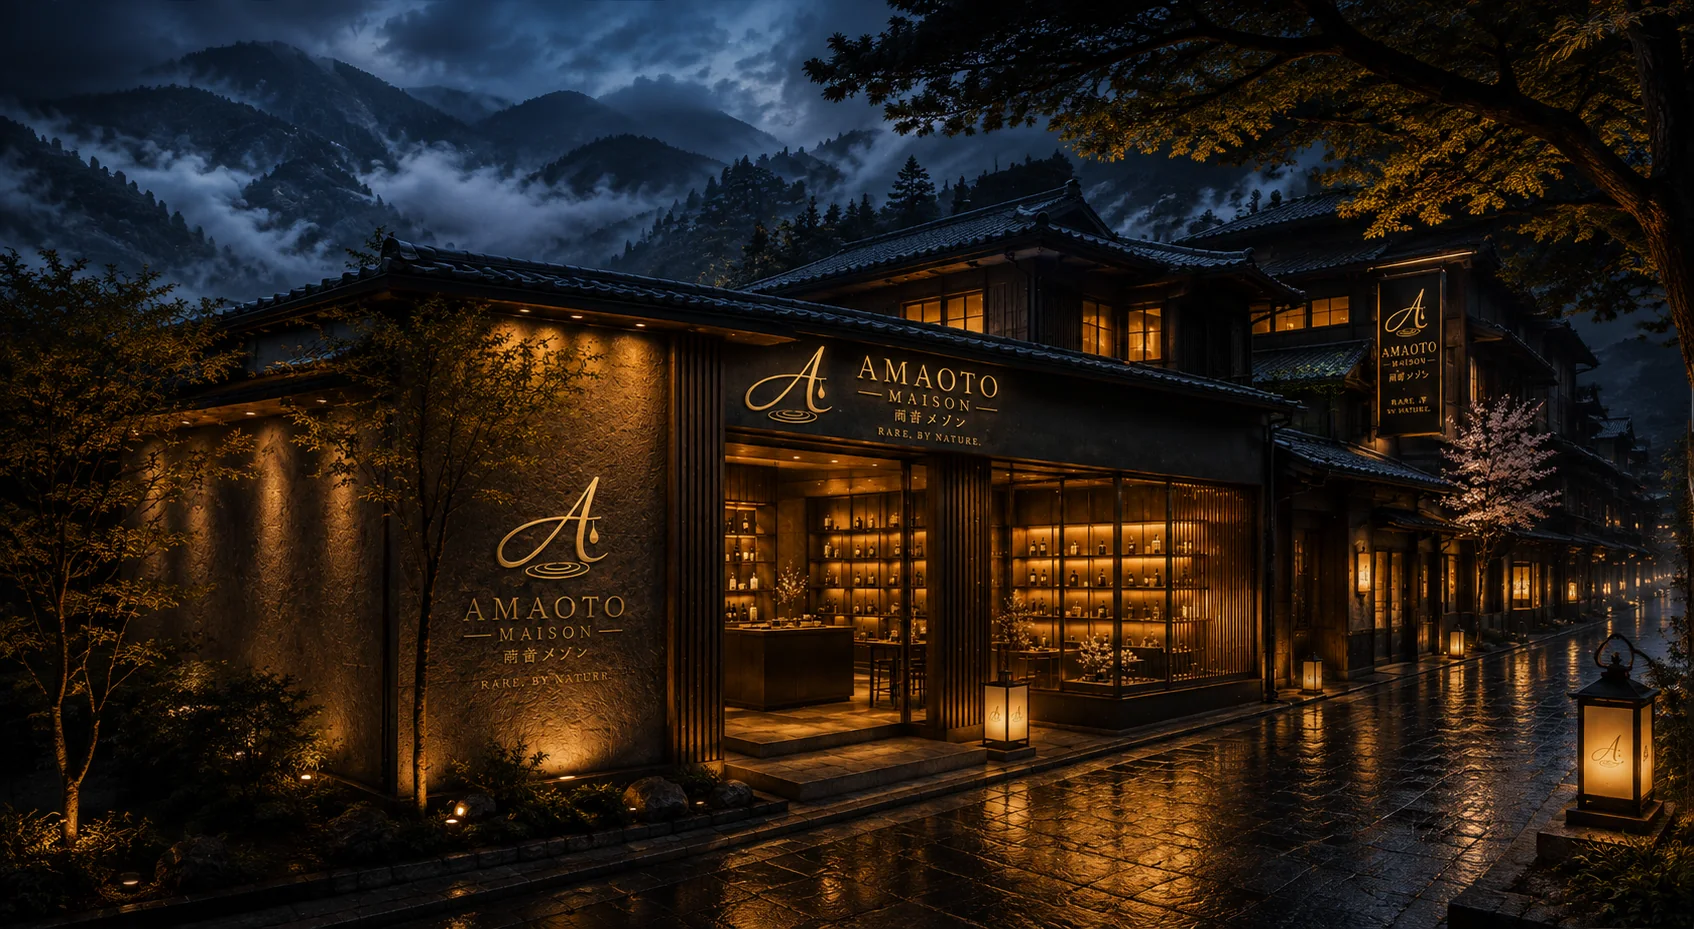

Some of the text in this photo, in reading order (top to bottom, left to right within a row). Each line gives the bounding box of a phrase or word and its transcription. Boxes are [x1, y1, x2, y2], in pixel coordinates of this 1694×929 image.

[1381, 341, 1437, 358] AMAOTO
[857, 355, 998, 399] AMAOTO
[888, 388, 971, 412] MAISON
[878, 427, 982, 446] RARE. BY NATURE.
[463, 595, 626, 622] AMAOTO
[499, 625, 593, 642] MAISON
[531, 675, 549, 686] BY
